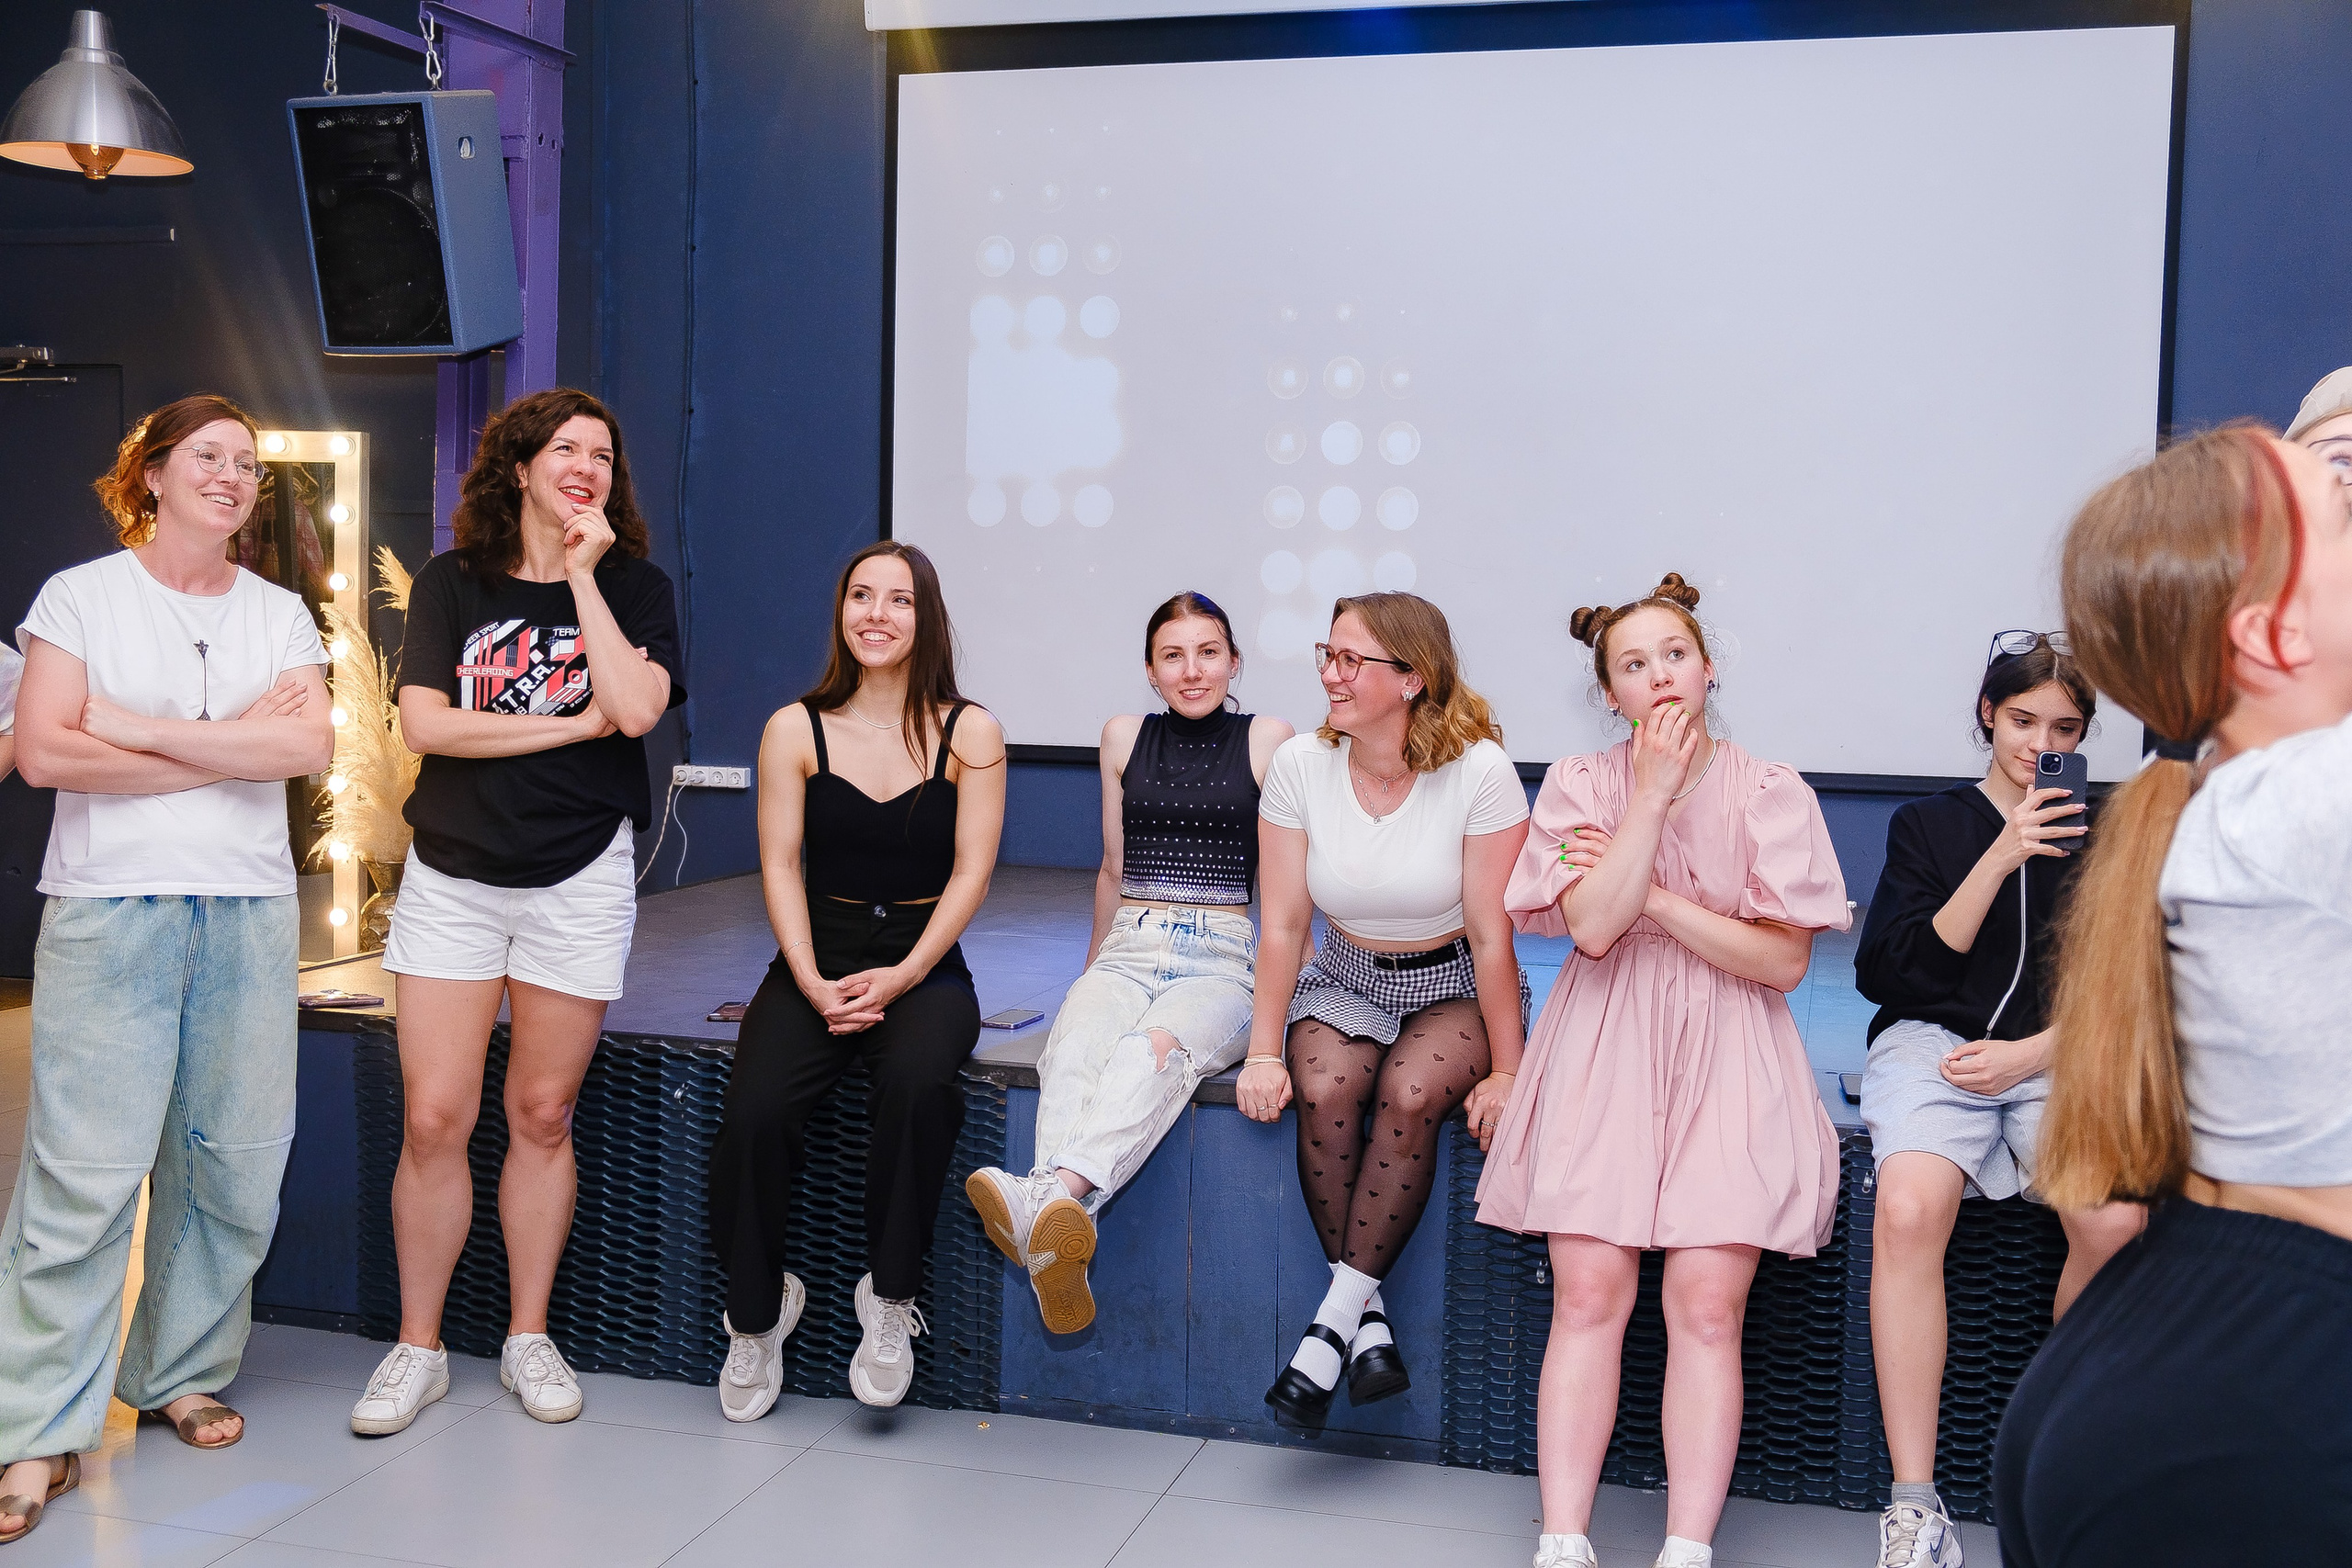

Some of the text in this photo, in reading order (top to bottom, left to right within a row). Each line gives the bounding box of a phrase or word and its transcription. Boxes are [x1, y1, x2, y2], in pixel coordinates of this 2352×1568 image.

[463, 621, 500, 650] HEER SPORT
[552, 627, 581, 637] TEAM
